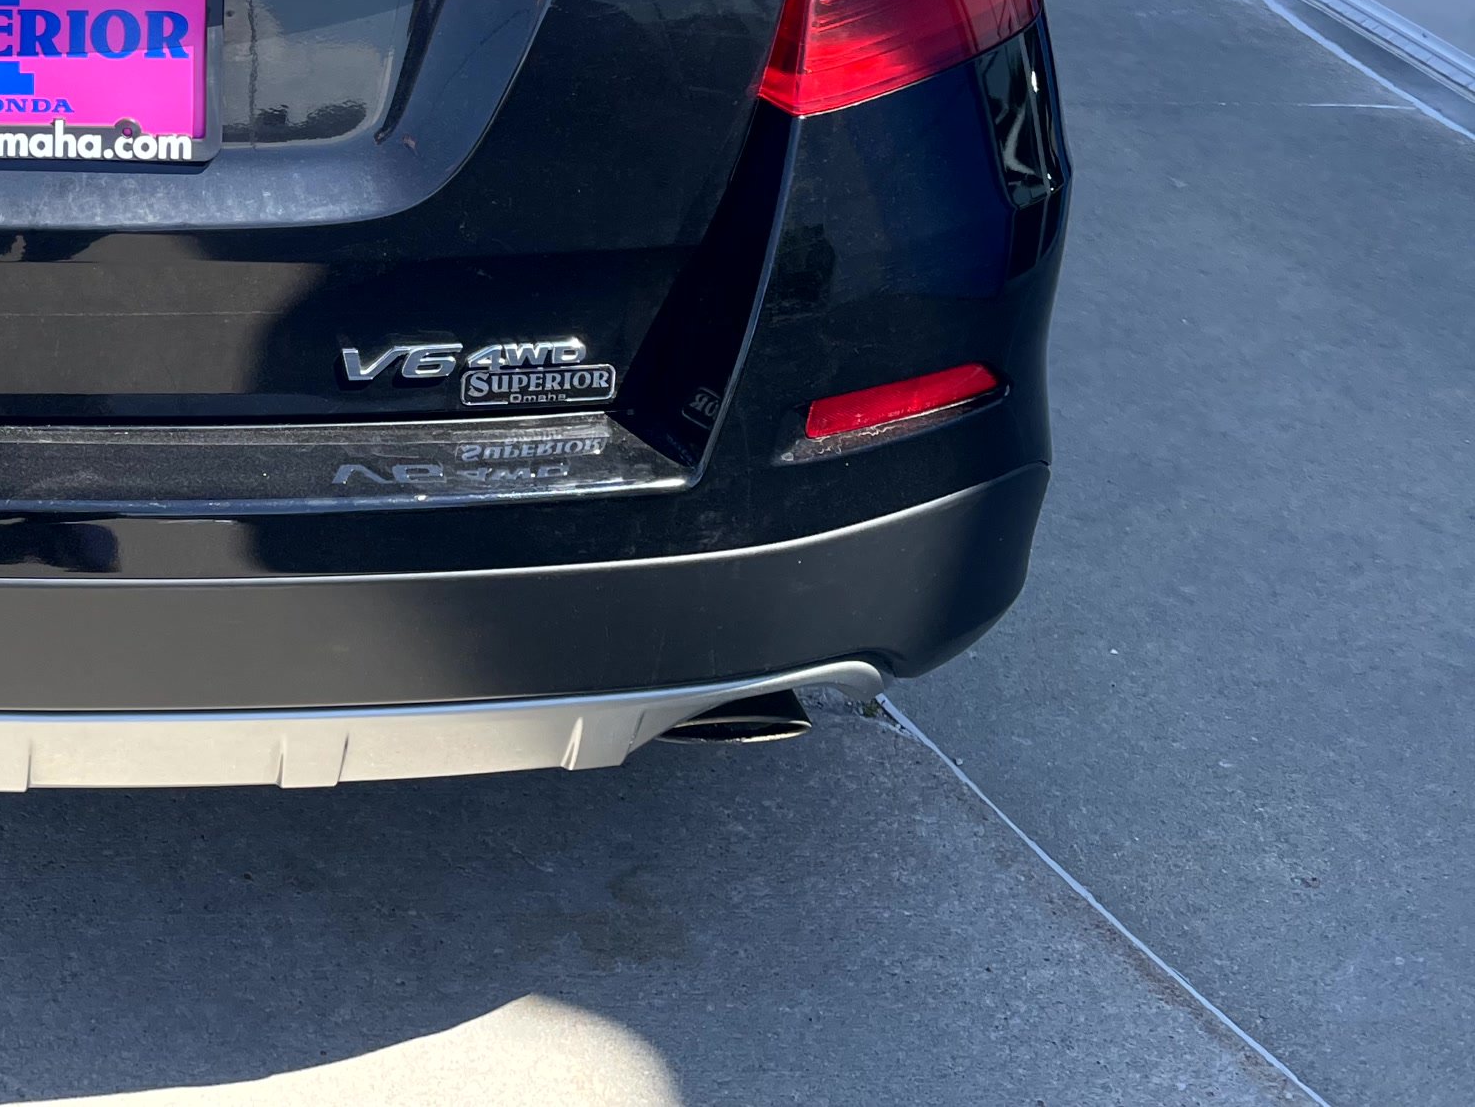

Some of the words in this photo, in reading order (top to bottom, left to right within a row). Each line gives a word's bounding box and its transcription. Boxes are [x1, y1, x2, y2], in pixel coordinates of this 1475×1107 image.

[342, 343, 463, 381] V6
[467, 338, 586, 371] 4WD
[468, 371, 610, 397] SUPERIOR
[510, 393, 567, 404] Omaha
